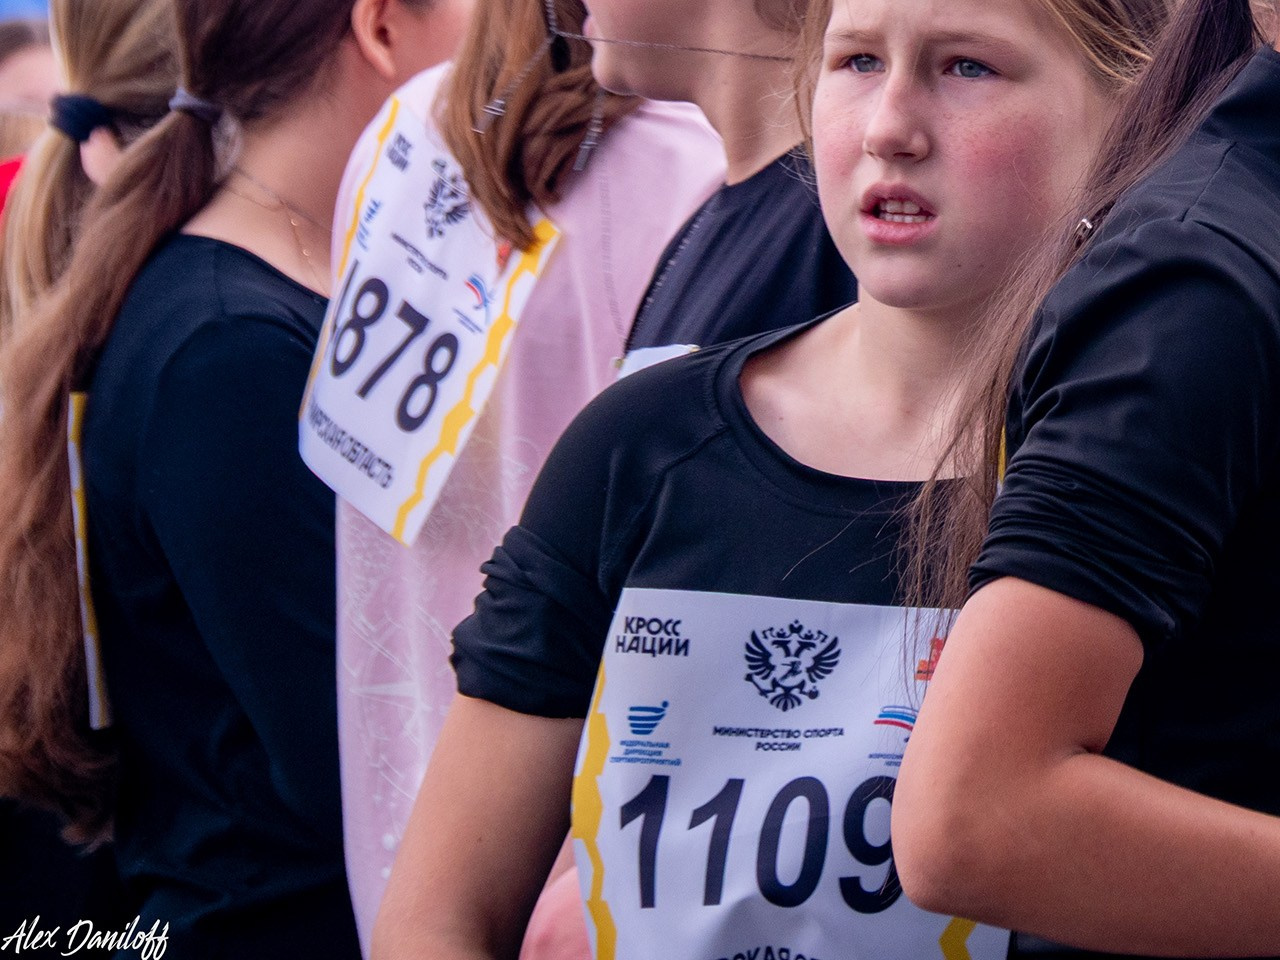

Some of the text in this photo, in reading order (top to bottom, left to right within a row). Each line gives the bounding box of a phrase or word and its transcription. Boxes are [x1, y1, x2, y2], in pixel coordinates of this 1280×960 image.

[624, 616, 682, 636] КРОСС
[615, 635, 690, 658] НАЦИИ
[712, 725, 845, 739] МИНИСТЕРСТВО СПОРТА
[755, 741, 802, 752] РОССИИ
[619, 774, 902, 915] 1109
